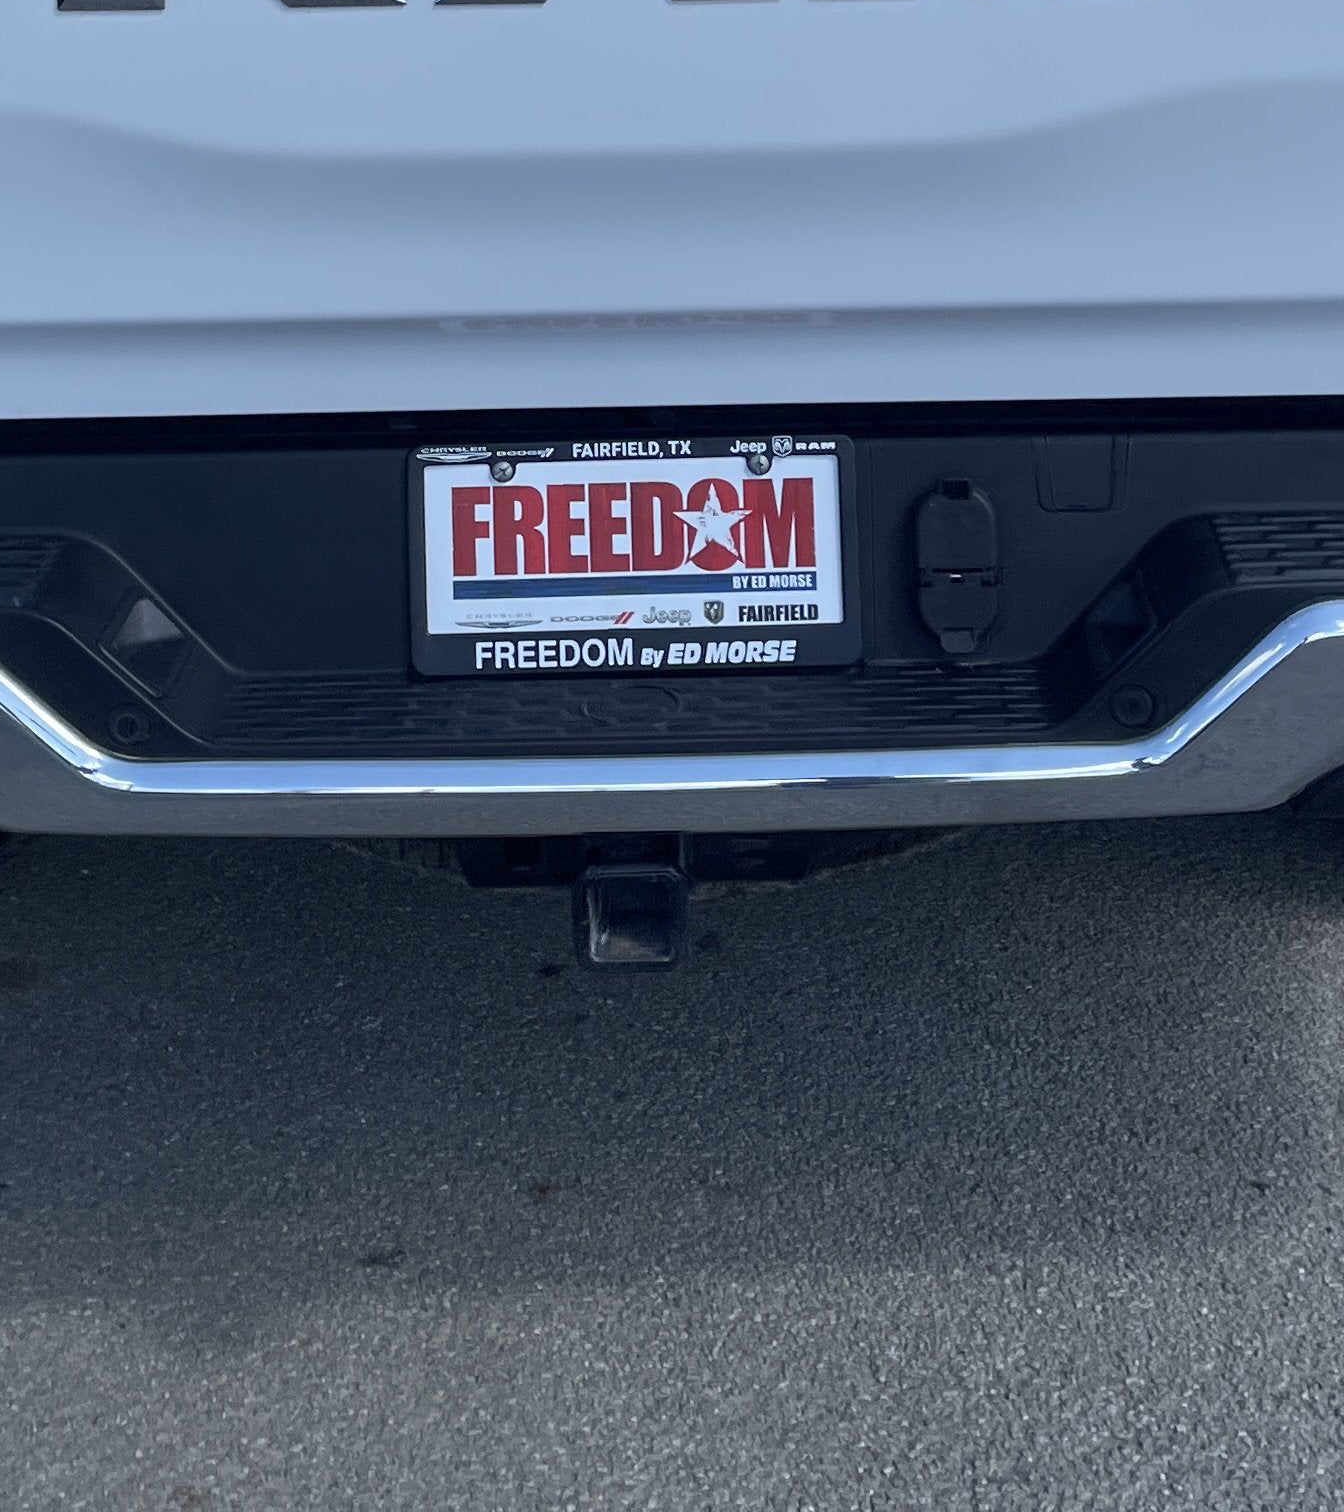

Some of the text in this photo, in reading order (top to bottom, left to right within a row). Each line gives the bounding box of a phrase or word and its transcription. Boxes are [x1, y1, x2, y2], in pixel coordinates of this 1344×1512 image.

[420, 446, 487, 454] CHRYSLER
[572, 439, 692, 459] FAIRFIELD, TX
[729, 439, 767, 455] Jeep
[795, 442, 836, 450] RAM
[451, 477, 816, 576] FREEDOM
[732, 573, 813, 589] BY ED MORSE
[642, 606, 692, 627] Jeep
[738, 603, 819, 622] FAIRFIELD
[475, 638, 634, 669] FREEDOM
[667, 642, 702, 665] ED
[704, 639, 797, 664] MORSE
